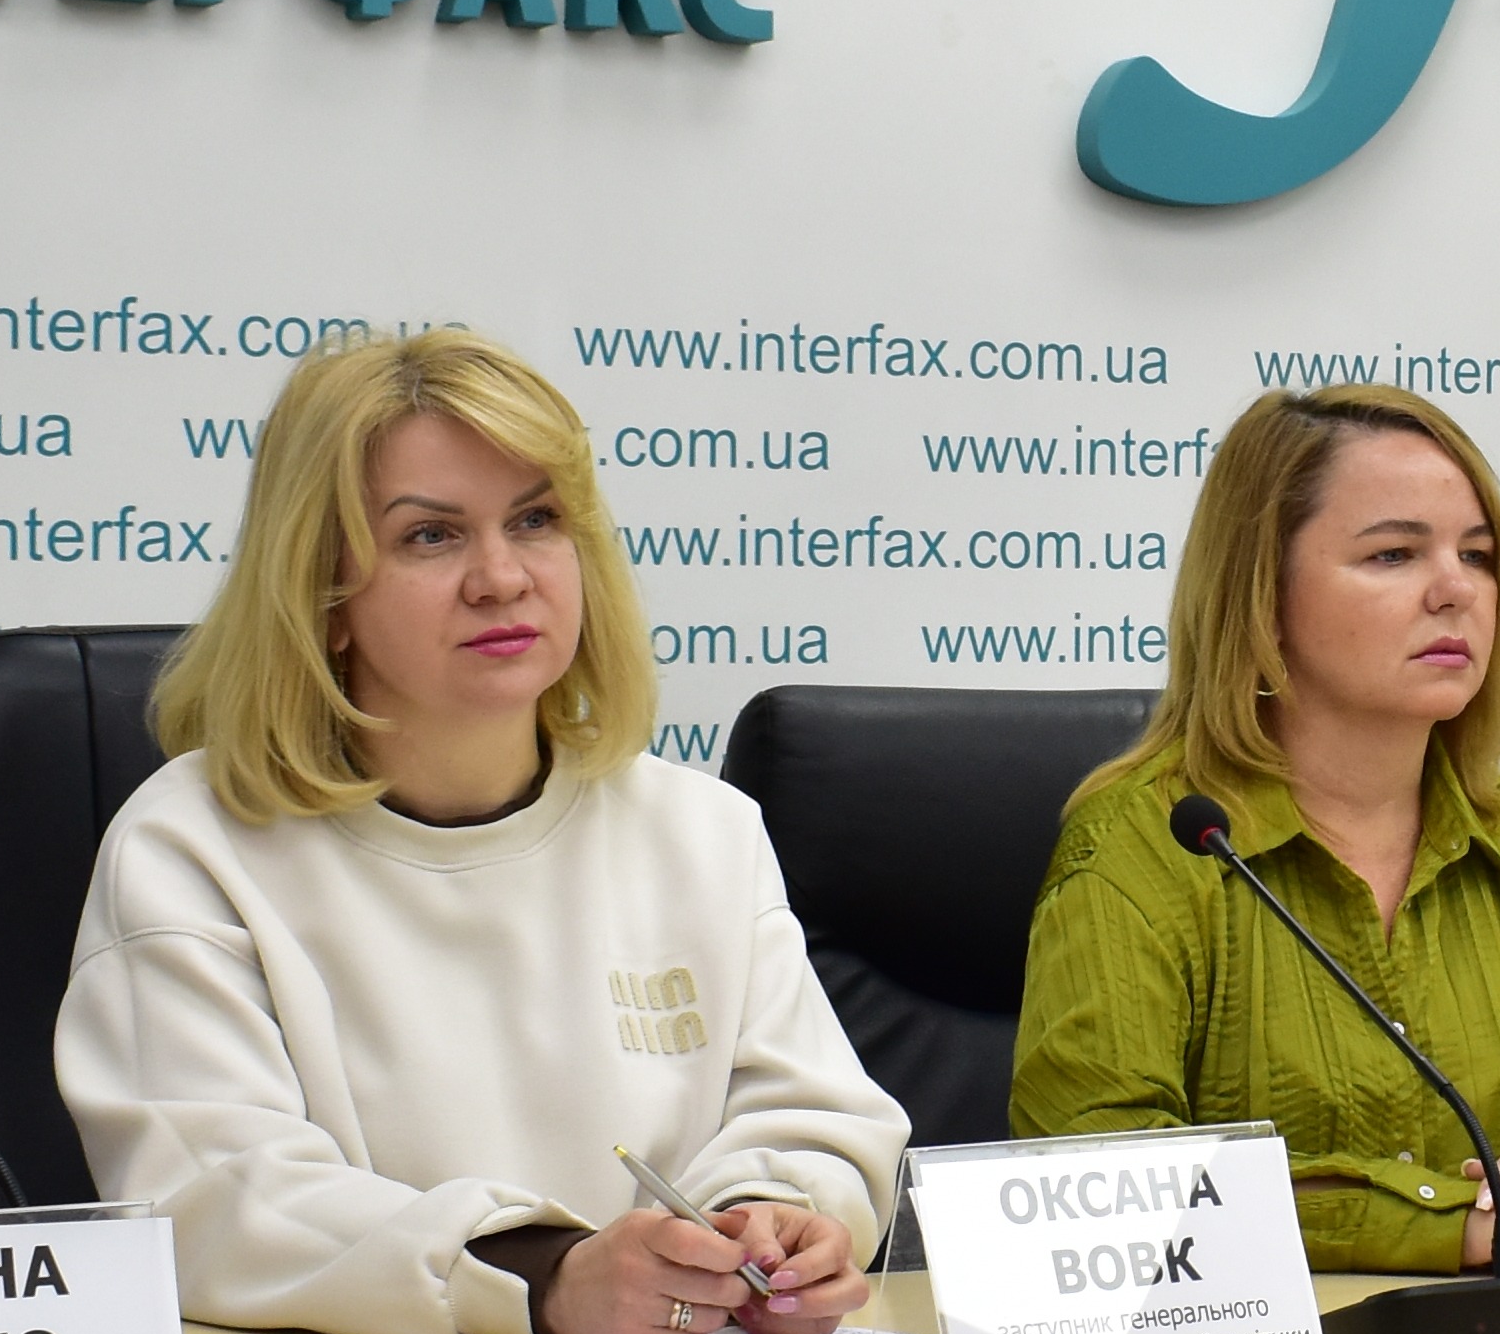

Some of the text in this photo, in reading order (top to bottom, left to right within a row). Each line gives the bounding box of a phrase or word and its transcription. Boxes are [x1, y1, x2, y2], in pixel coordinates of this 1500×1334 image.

[573, 318, 1167, 384] www.interfax.com.ua
[616, 515, 1167, 570] ww.interfax.com.ua
[999, 1163, 1224, 1225] ОКСАНА
[1051, 1236, 1204, 1295] ВОВК
[1119, 1297, 1270, 1334] генерального
